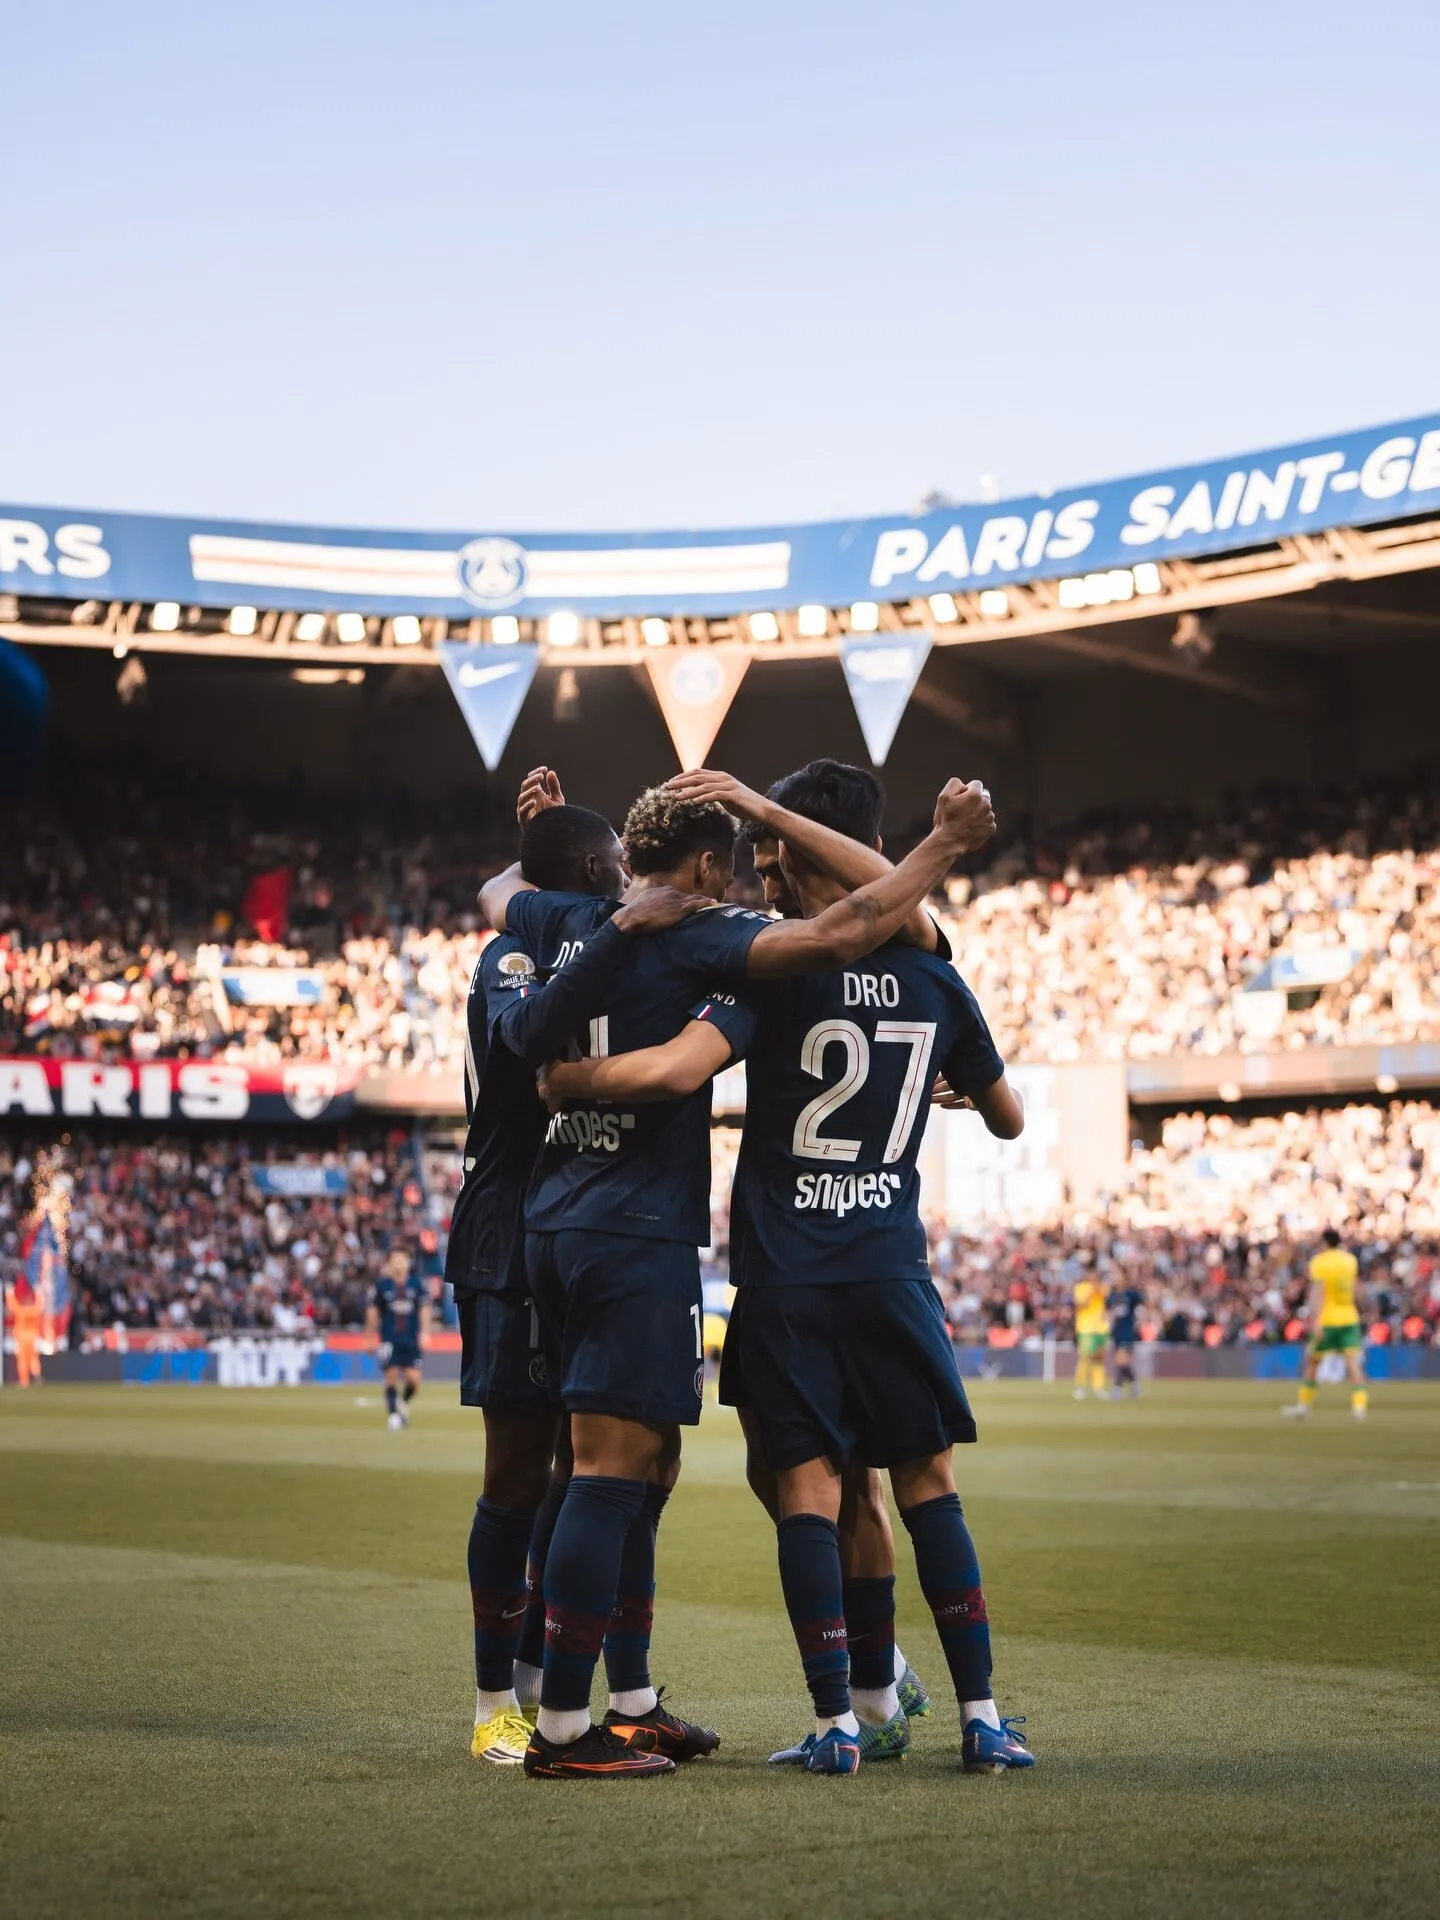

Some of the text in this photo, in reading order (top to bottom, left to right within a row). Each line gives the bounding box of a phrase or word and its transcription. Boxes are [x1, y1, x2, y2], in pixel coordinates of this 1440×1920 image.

[0, 518, 112, 579] RS
[869, 499, 1101, 587] PARIS
[843, 972, 900, 1008] DRO
[0, 1060, 250, 1120] ARIS
[792, 1018, 938, 1164] 27
[545, 1110, 621, 1153] nipes
[794, 1171, 894, 1218] snipes
